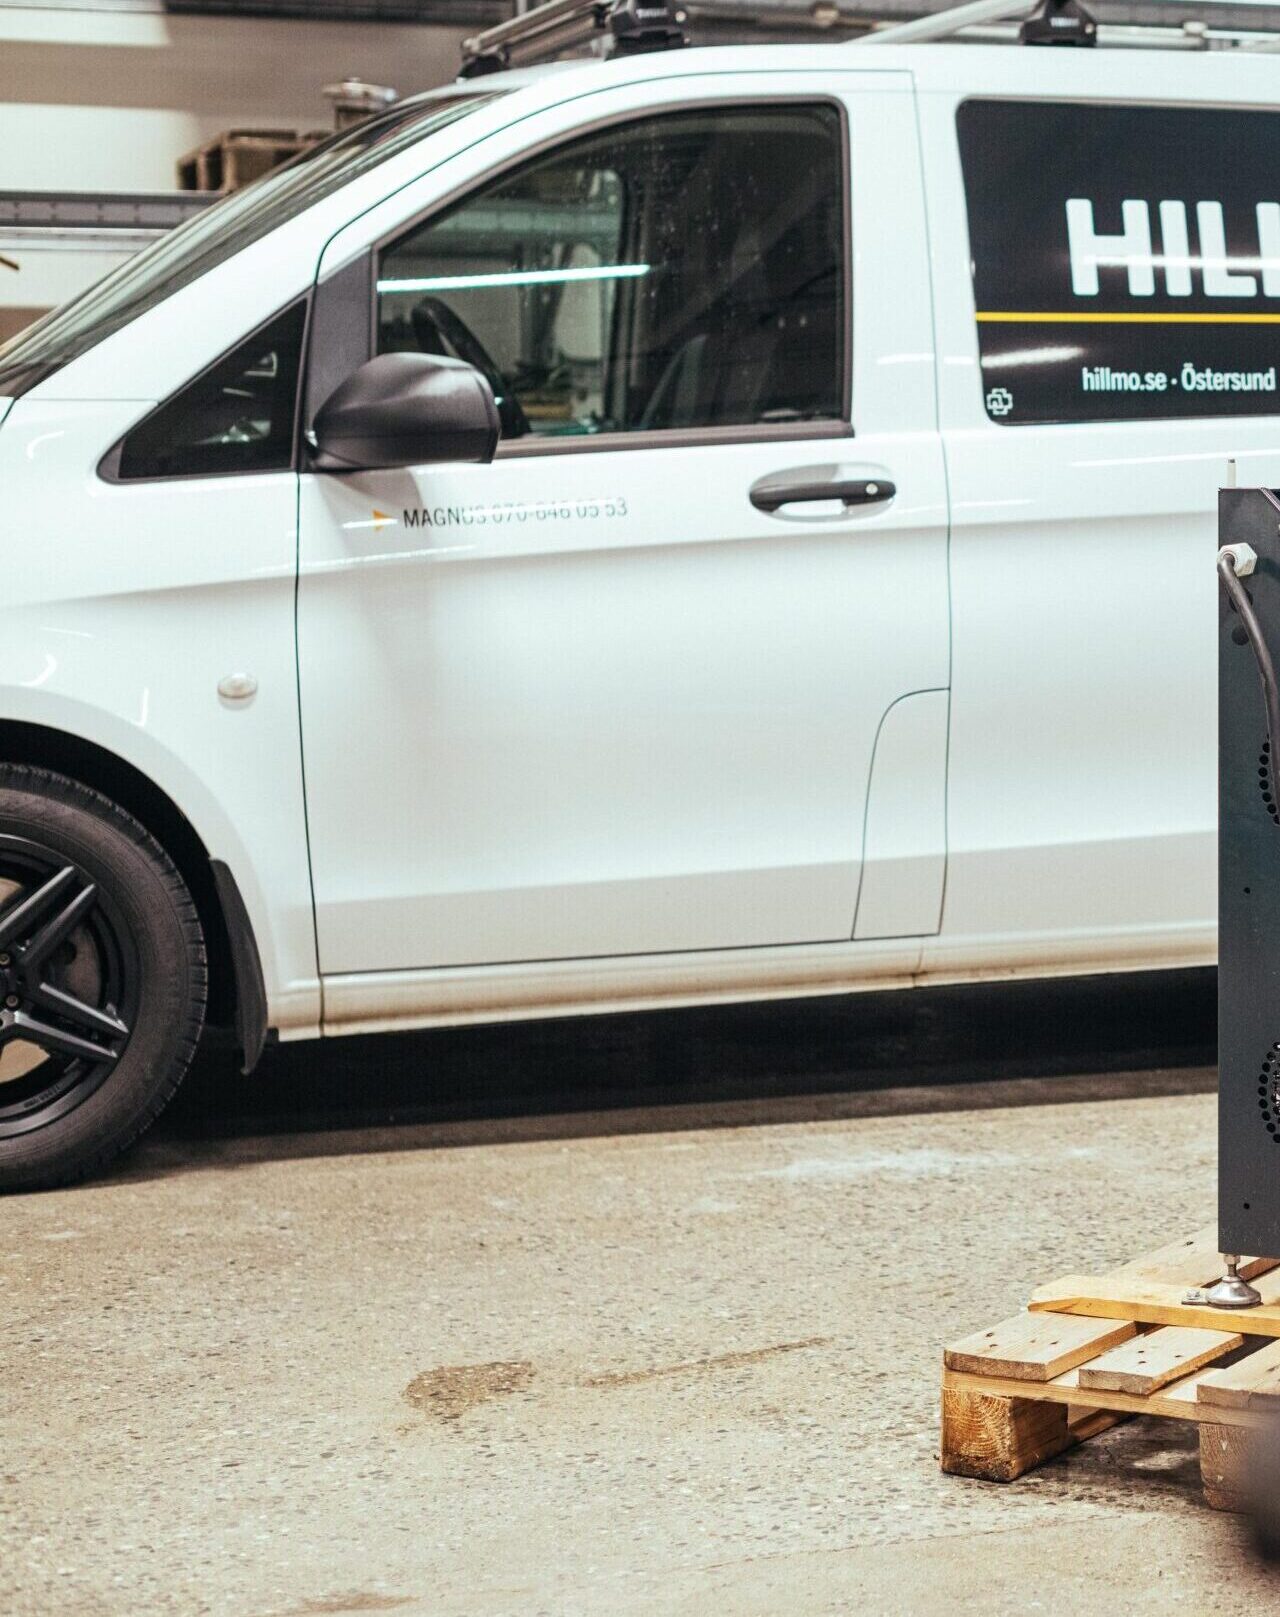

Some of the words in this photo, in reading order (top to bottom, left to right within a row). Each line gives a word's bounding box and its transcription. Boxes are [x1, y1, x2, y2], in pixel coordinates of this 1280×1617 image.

[1082, 366, 1168, 391] hillmo.se
[1181, 362, 1276, 391] Östersund
[403, 504, 486, 528] MAGNUS
